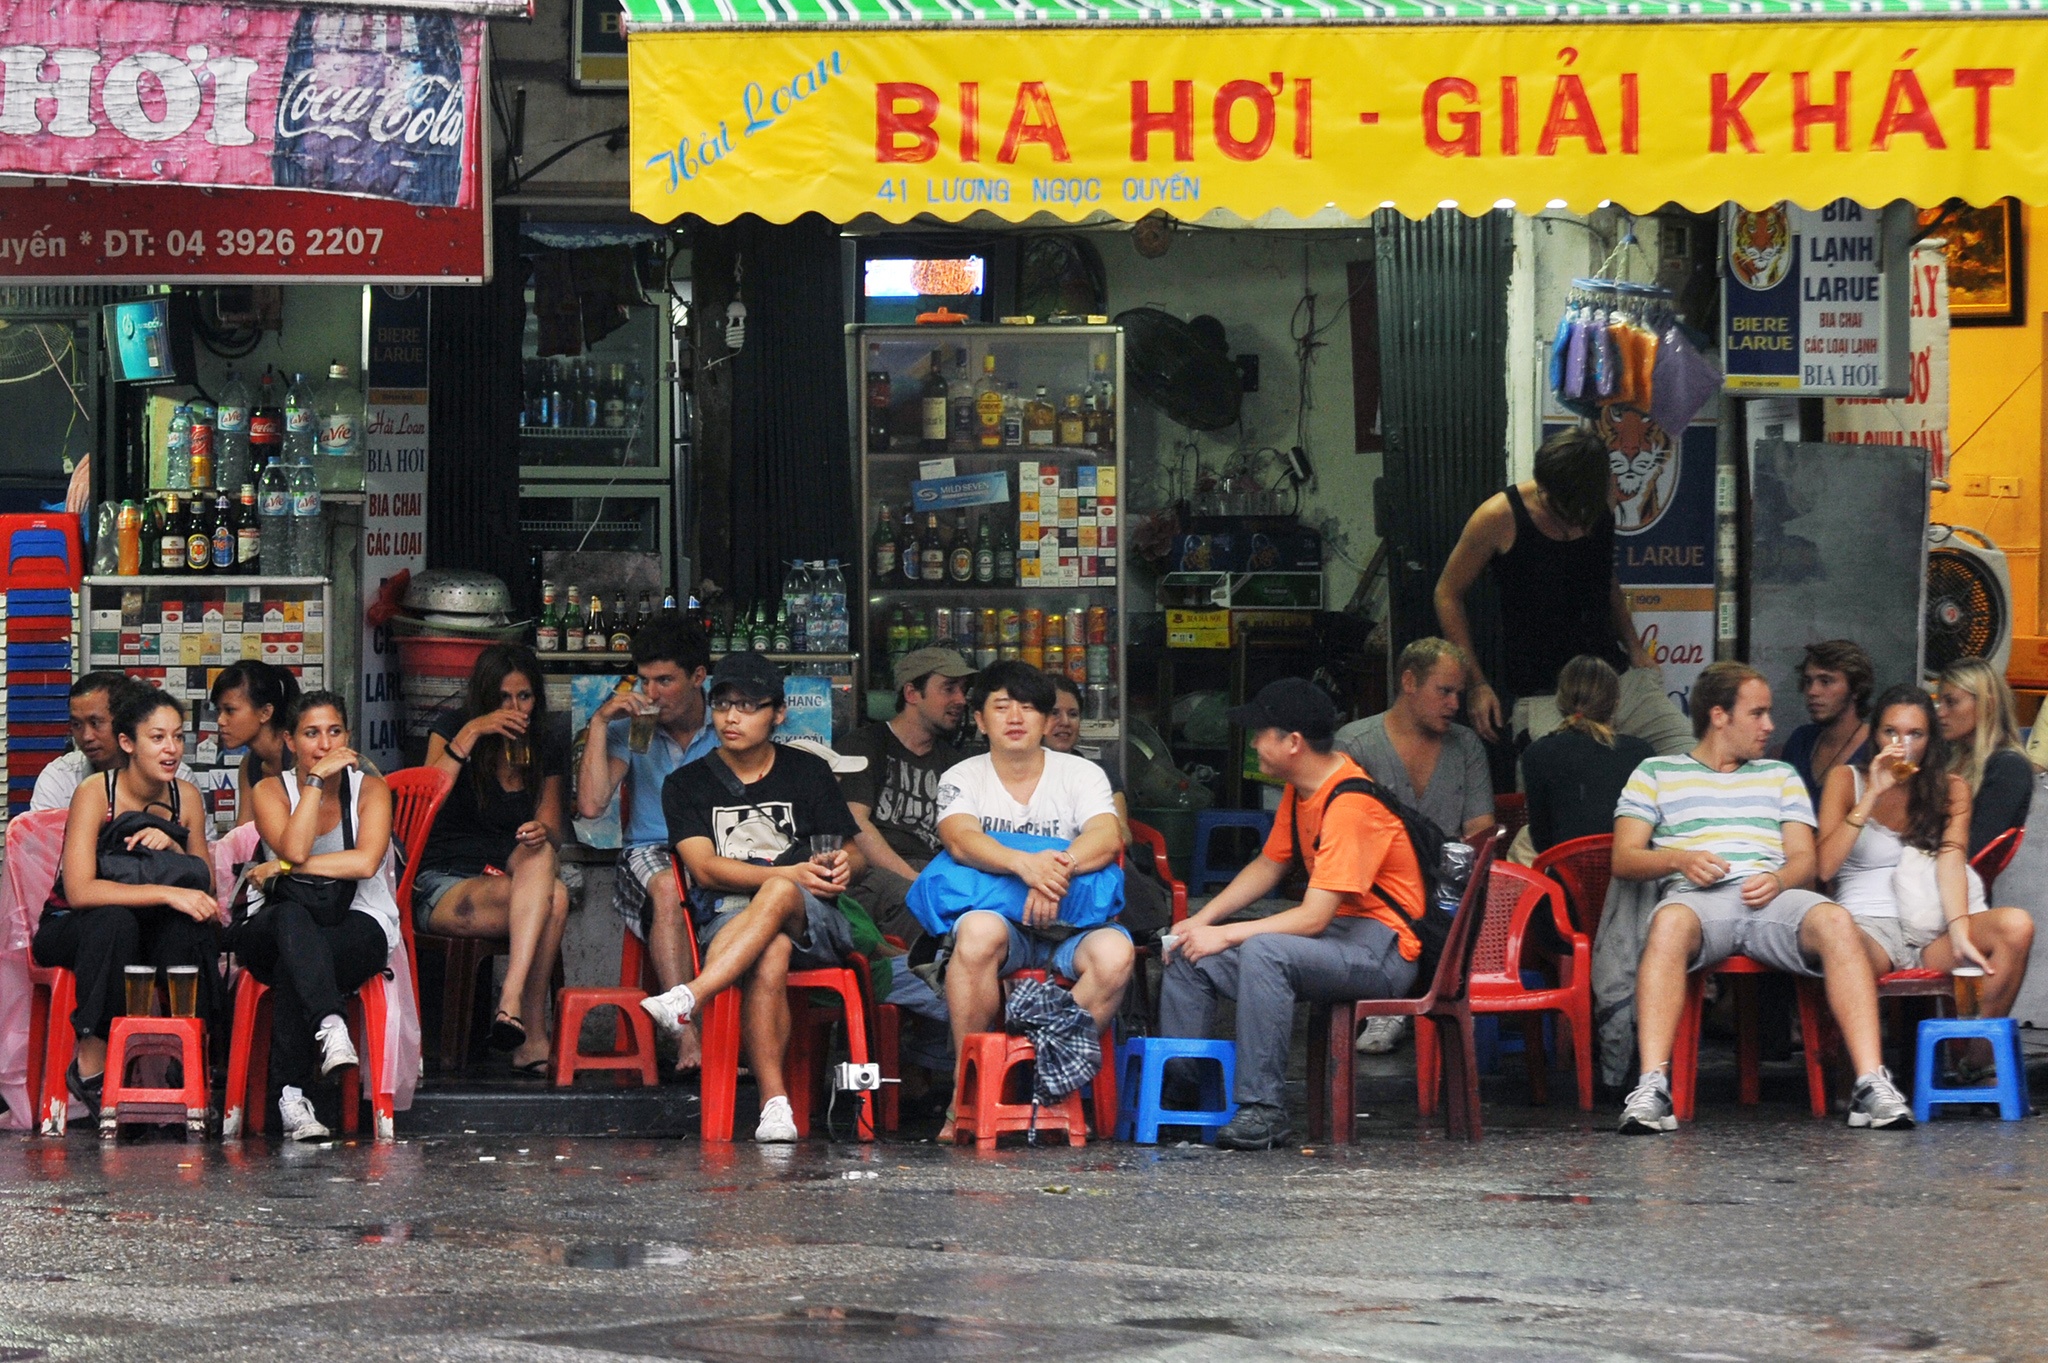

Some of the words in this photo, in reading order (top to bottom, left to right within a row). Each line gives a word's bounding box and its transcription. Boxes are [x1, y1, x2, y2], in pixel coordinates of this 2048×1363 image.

[876, 79, 1071, 164] BIA
[1130, 71, 1312, 162] HƠI
[1359, 112, 1379, 125] -
[1421, 47, 1640, 158] GIẢI
[1709, 48, 2015, 155] KHÁT
[646, 120, 736, 194] Hải
[743, 50, 850, 138] Loan
[877, 178, 908, 204] 41
[1032, 177, 1101, 208] NGỌC
[1121, 170, 1201, 203] QUYẾN
[104, 229, 155, 257] ĐT:
[167, 228, 206, 257] 04
[216, 228, 295, 257] 3926
[305, 227, 384, 257] 2207
[1810, 236, 1873, 267] LẠNH
[1804, 276, 1879, 301] LARUE
[1732, 317, 1789, 332] BIERE
[1819, 312, 1836, 328] BIA
[1840, 312, 1863, 328] CHAI
[1728, 336, 1794, 351] LARUE
[1804, 336, 1823, 354] CÁC
[1826, 338, 1848, 357] LOẠI
[1851, 338, 1877, 357] LẠNH
[1804, 364, 1836, 386] BIA
[1841, 362, 1878, 387] HƠI
[395, 412, 425, 435] Loan
[367, 449, 392, 473] BIA
[397, 447, 425, 473] HƠI
[940, 484, 962, 495] MILD
[962, 481, 990, 493] SEVEN
[369, 493, 390, 517] BIA
[392, 493, 421, 517] CHAI
[367, 528, 391, 556] CÁC
[394, 532, 422, 560] LOẠI
[1627, 545, 1706, 566] LARUE
[1641, 623, 1704, 664] Loan
